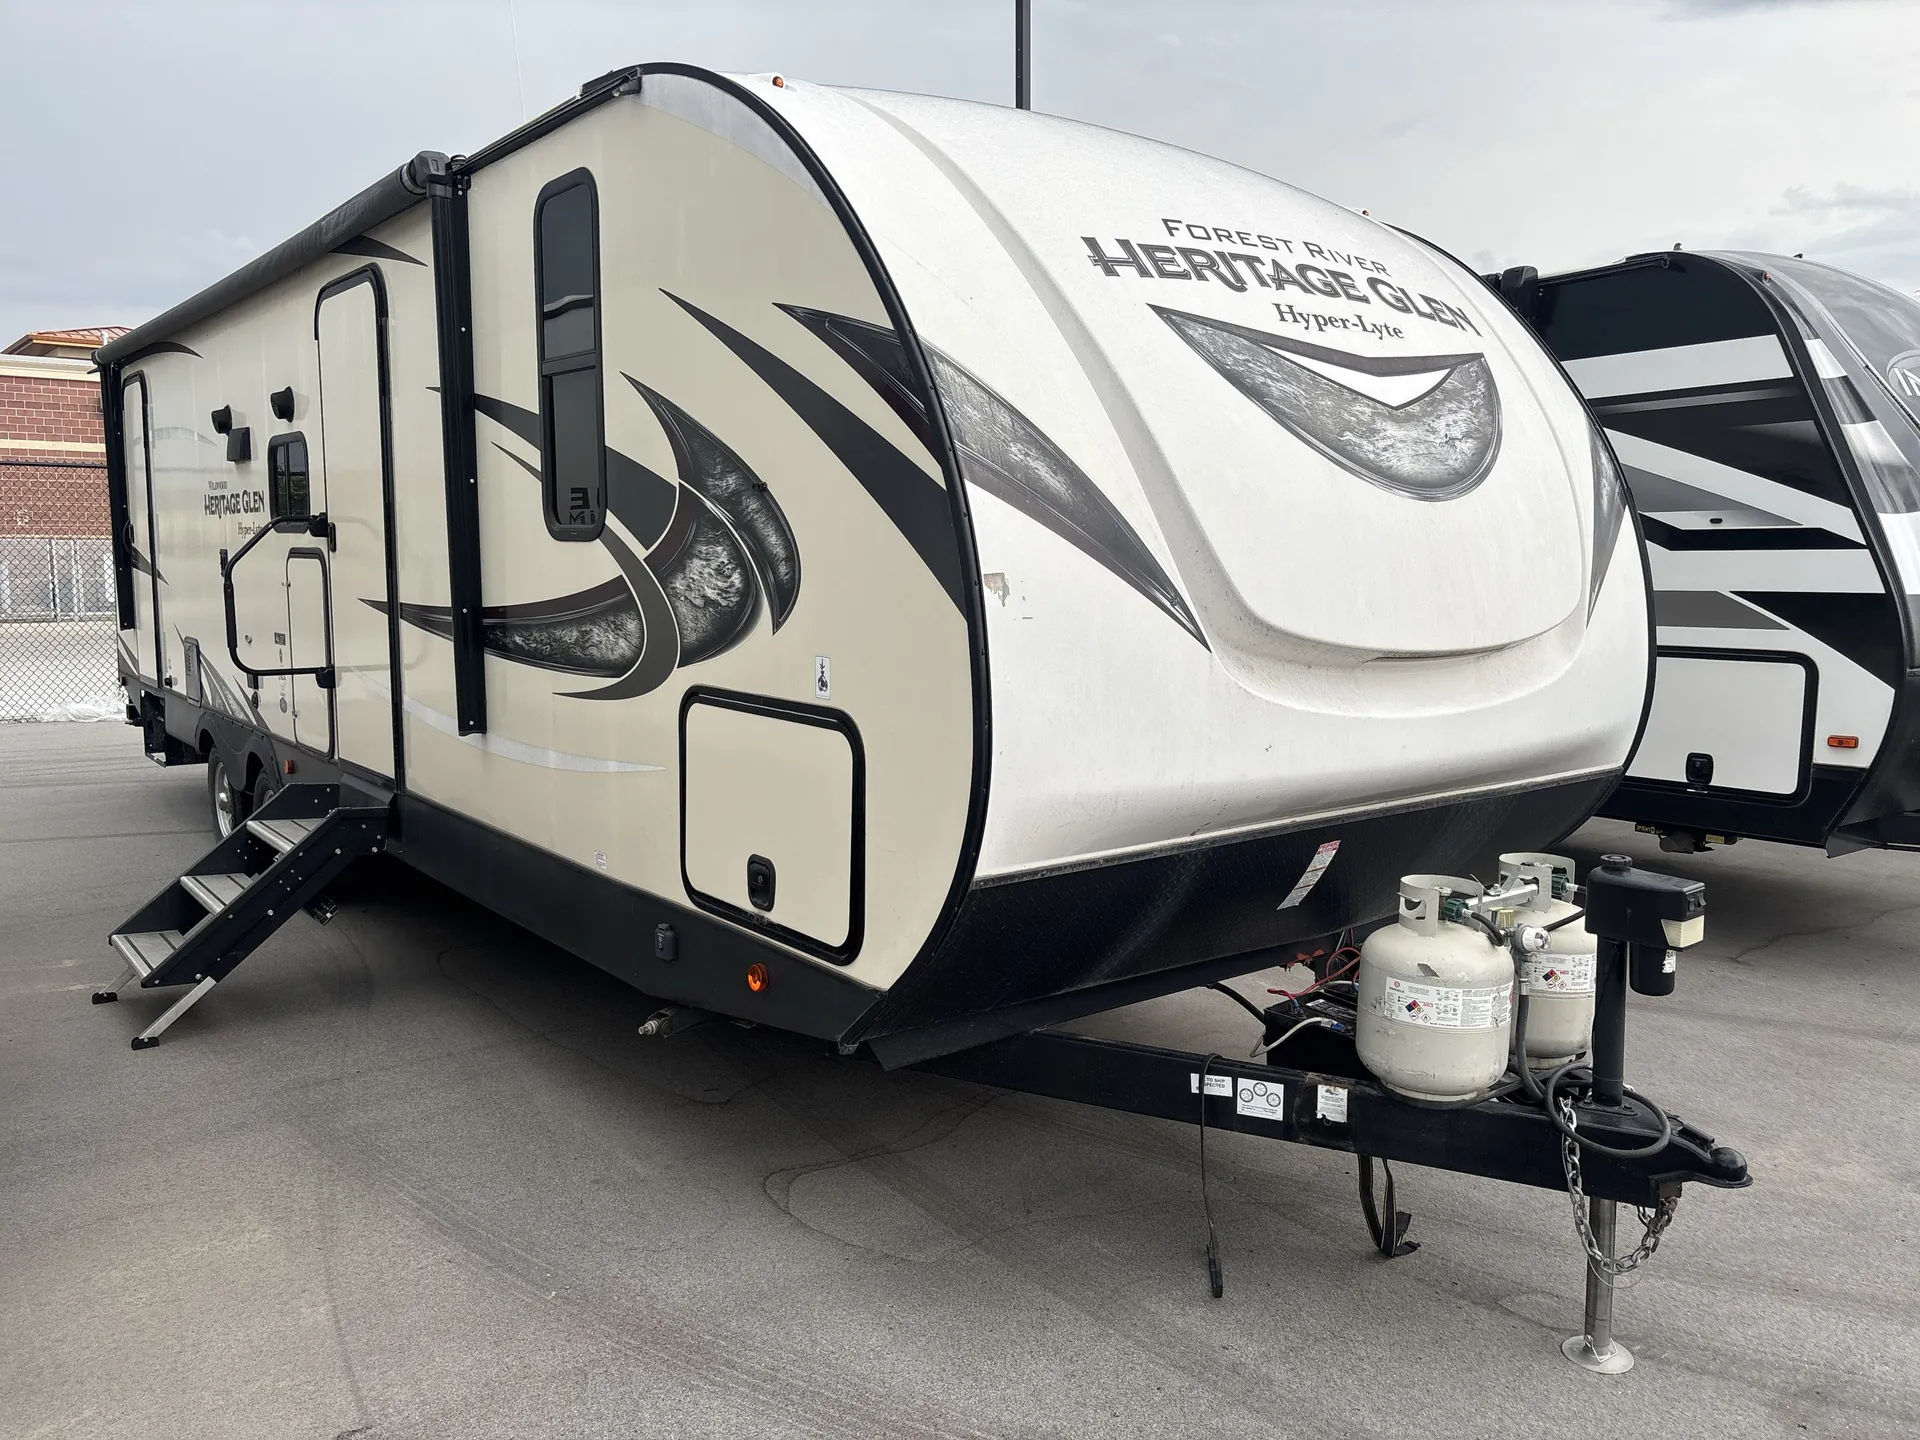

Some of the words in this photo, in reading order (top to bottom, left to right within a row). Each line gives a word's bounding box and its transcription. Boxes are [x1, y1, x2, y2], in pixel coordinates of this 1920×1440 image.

[1161, 218, 1292, 254] FOREST
[1304, 242, 1391, 277] RIVER
[1080, 236, 1371, 305] HERITAGE
[1366, 277, 1483, 338] GLEN
[1272, 302, 1405, 340] Hyper-Lyte
[204, 493, 241, 519] HERITAGE
[242, 490, 265, 514] GLEN
